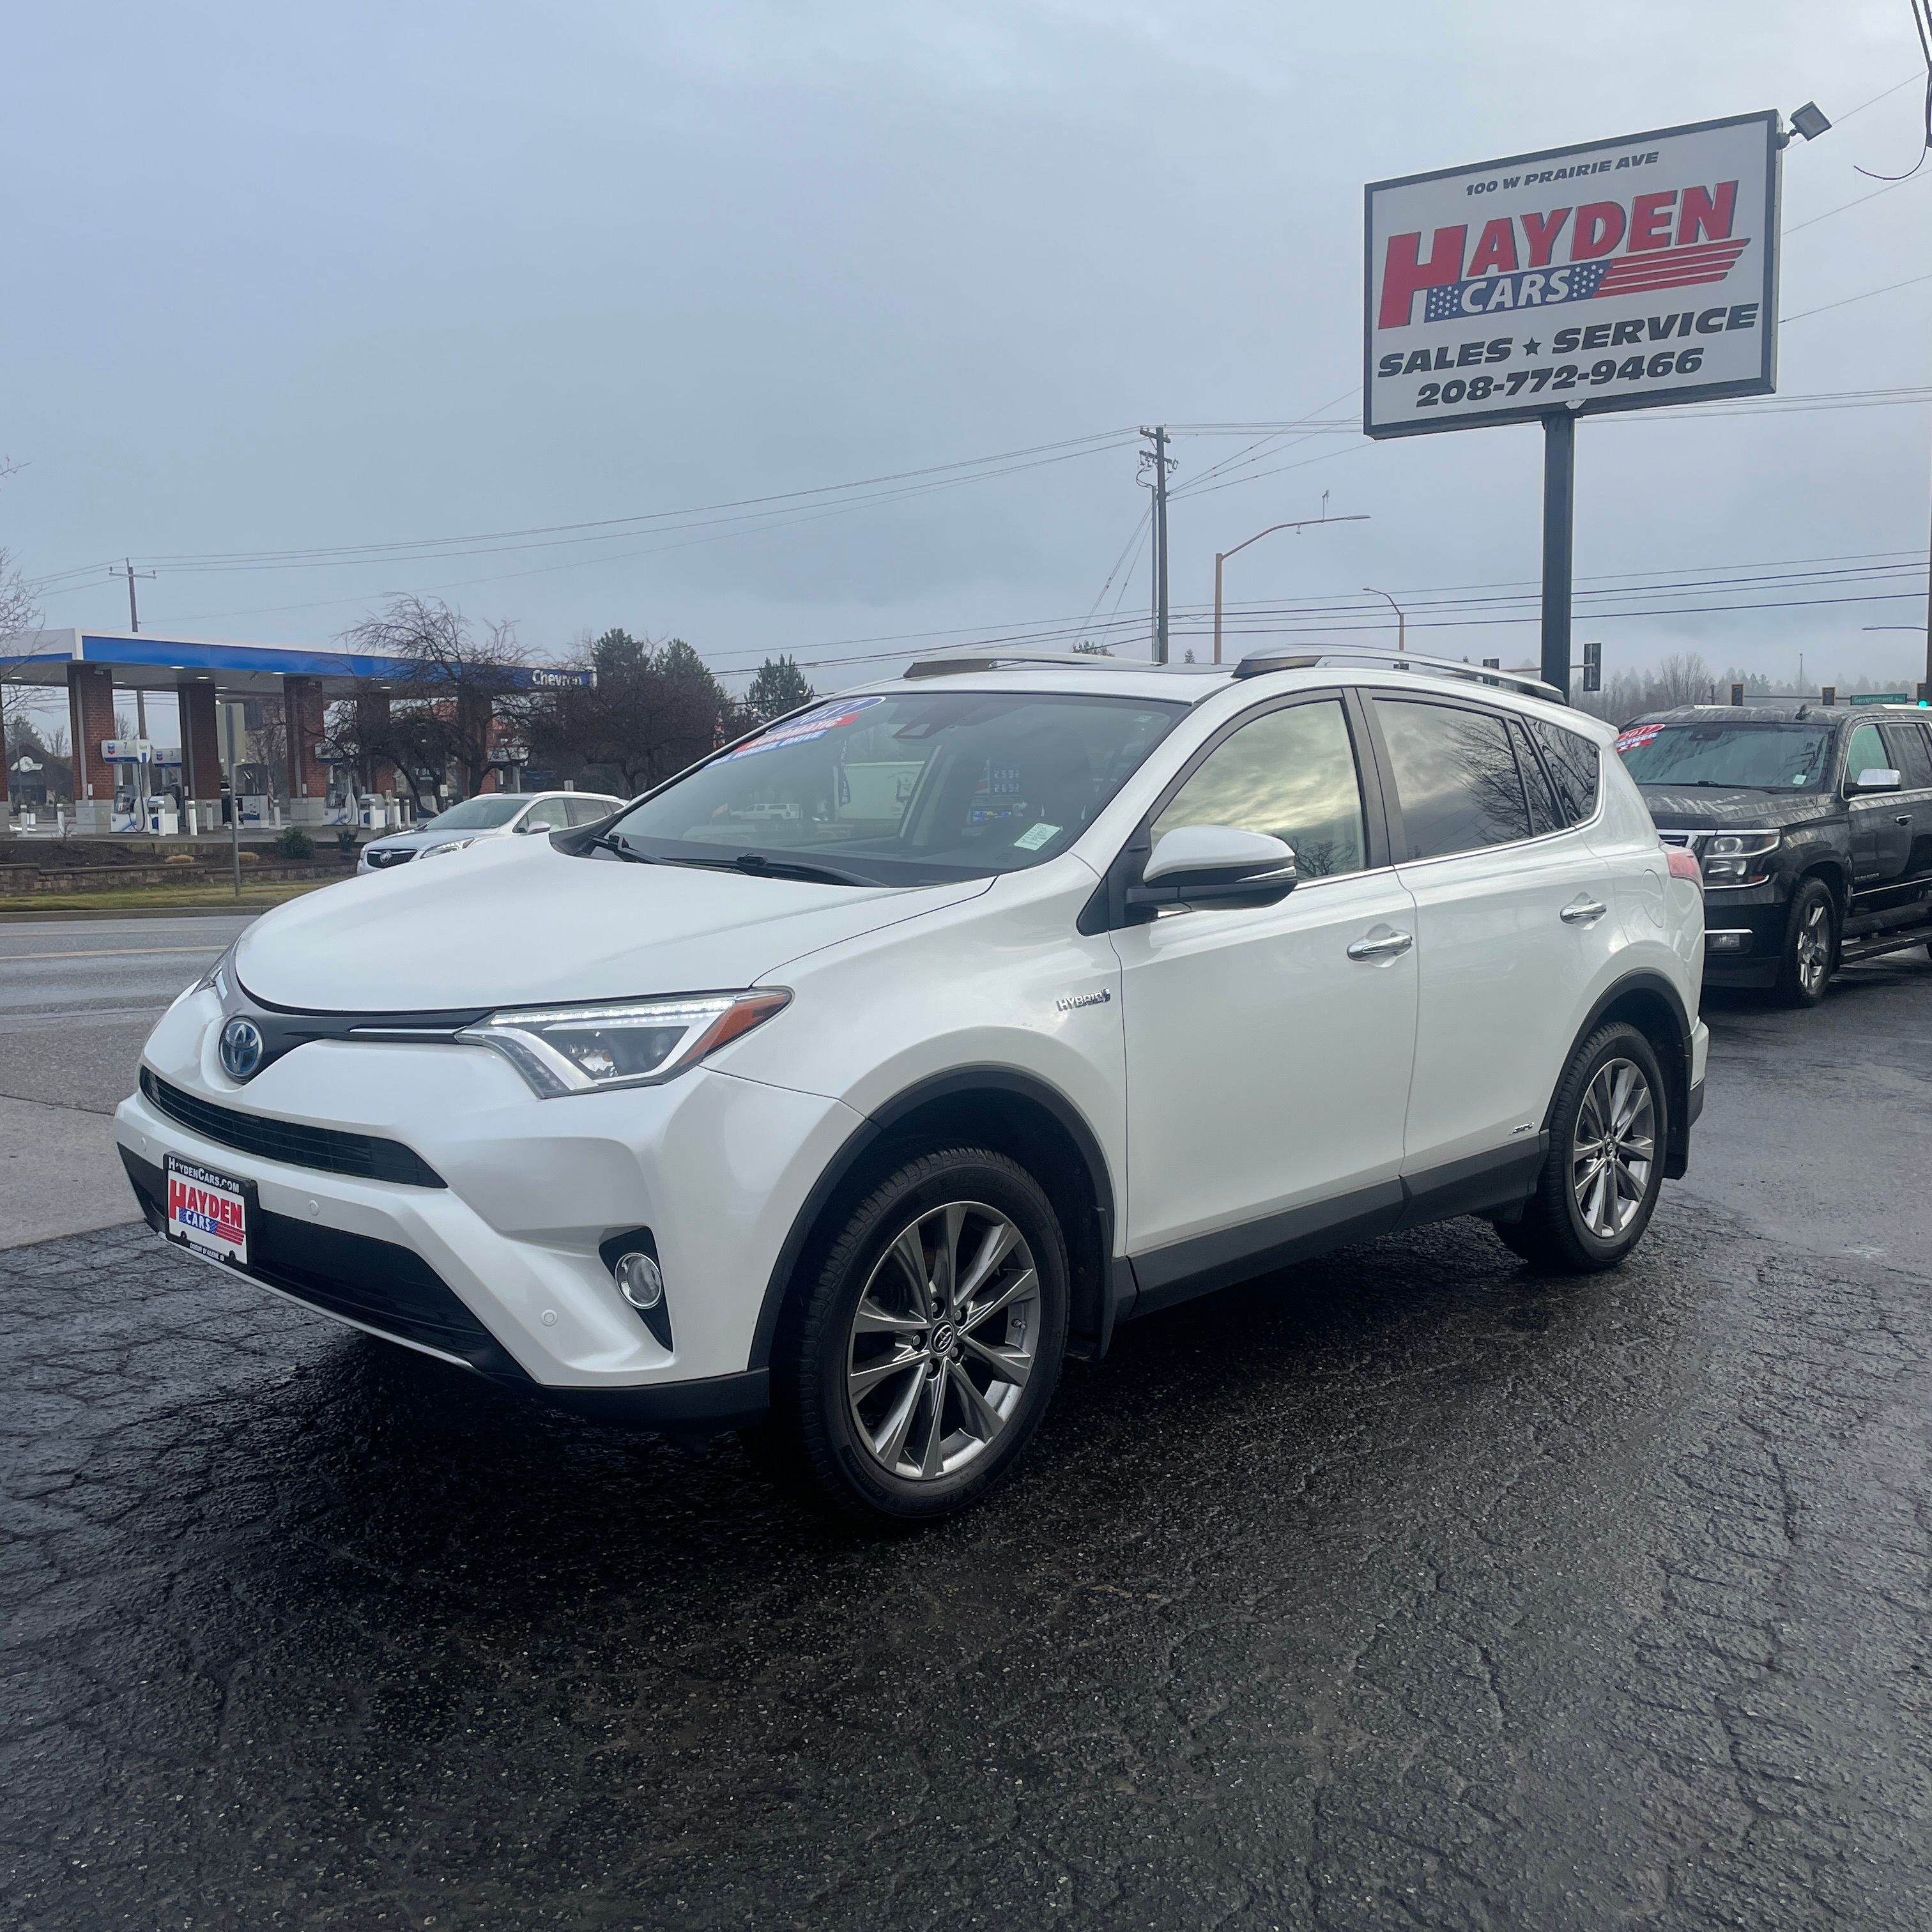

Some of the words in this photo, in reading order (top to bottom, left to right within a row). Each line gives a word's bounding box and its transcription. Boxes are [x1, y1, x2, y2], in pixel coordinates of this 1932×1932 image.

[1466, 180, 1498, 196] 100
[1503, 176, 1521, 189] W
[1524, 160, 1612, 186] PRAIRIE
[1615, 151, 1660, 170] AVE
[1377, 180, 1739, 330] HAYDEN
[1460, 268, 1572, 313] CARS
[1377, 337, 1514, 378] SALES
[1552, 302, 1759, 354] SERVICE
[1416, 347, 1705, 408] 208-772-9466
[532, 670, 582, 686] Chevron
[1618, 725, 1657, 740] 2017
[1056, 992, 1103, 1012] HYBRID
[169, 1179, 242, 1229] HAYDEN
[185, 1210, 211, 1232] CARS
